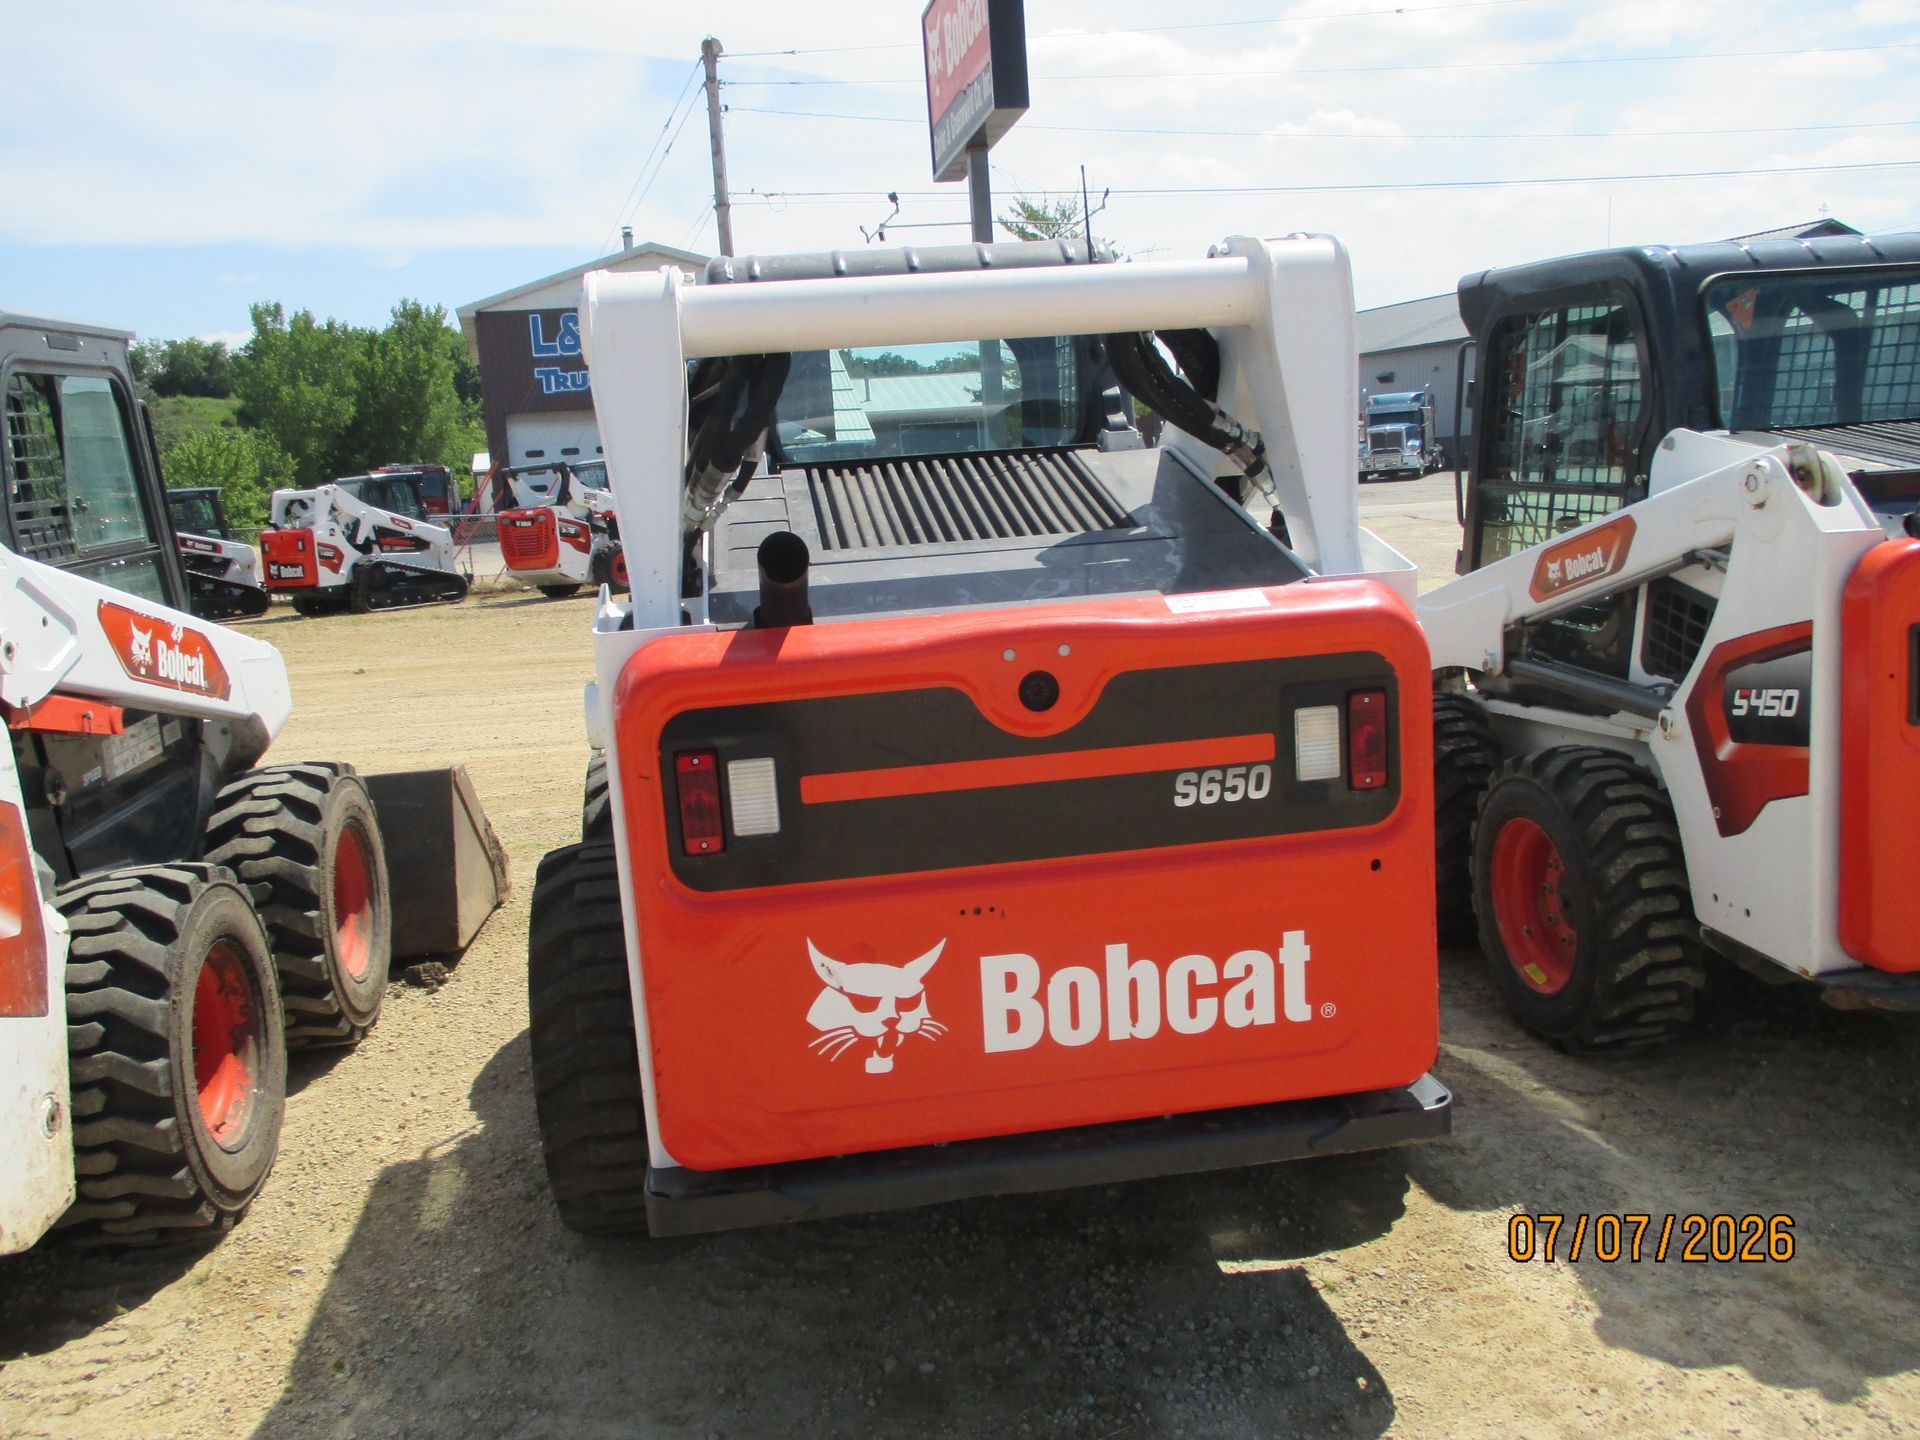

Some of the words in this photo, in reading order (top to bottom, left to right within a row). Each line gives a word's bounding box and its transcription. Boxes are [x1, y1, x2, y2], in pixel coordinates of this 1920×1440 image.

[534, 366, 591, 394] TRU
[1564, 546, 1604, 581] Bobcat
[156, 639, 206, 689] Bobcat
[1732, 688, 1800, 718] S450
[1173, 764, 1272, 808] S650
[979, 930, 1312, 1054] Bobcat
